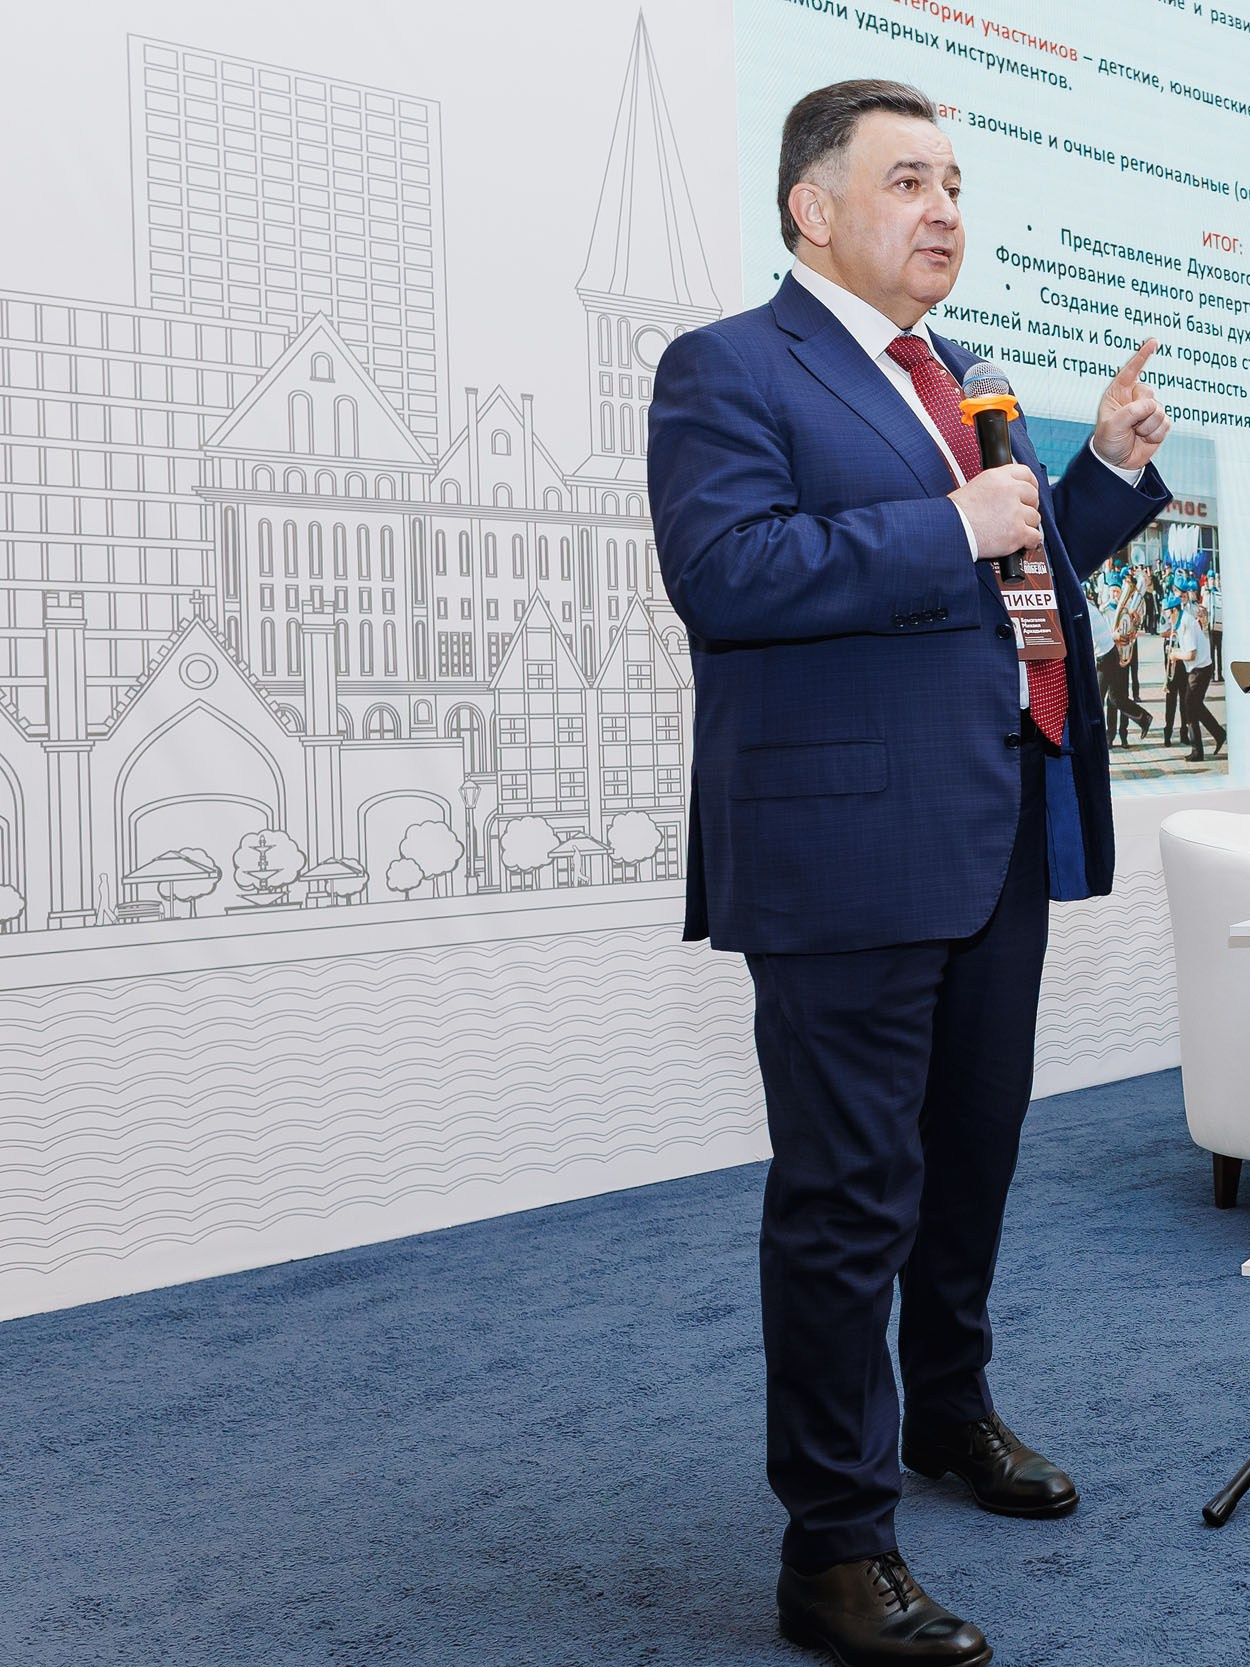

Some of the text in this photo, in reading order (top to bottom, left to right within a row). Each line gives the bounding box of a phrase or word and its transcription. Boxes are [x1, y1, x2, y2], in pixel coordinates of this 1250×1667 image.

[1194, 3, 1202, 16] и
[855, 9, 939, 49] ударных
[946, 39, 1072, 91] инструментов.
[982, 19, 1077, 61] участников
[1098, 58, 1164, 92] детские,
[968, 112, 1042, 144] заочные
[1049, 135, 1057, 149] и
[1064, 140, 1115, 164] очные
[1121, 155, 1229, 195] региональные
[1061, 228, 1181, 271] Представление
[1203, 231, 1242, 254] ИТОГ:
[996, 245, 1125, 288] Формирование
[1131, 279, 1193, 302] единого
[944, 304, 1021, 331] жителей
[1028, 320, 1084, 342] малых
[1089, 331, 1098, 344] и
[1104, 329, 1172, 357] больих
[1178, 347, 1237, 369] городов
[1040, 287, 1118, 317] Создание
[1125, 307, 1181, 329] единой
[1187, 315, 1222, 337] базы
[1001, 347, 1057, 368] нашей
[1138, 369, 1247, 398] опричастность
[1003, 593, 1052, 607] ПИКЕР
